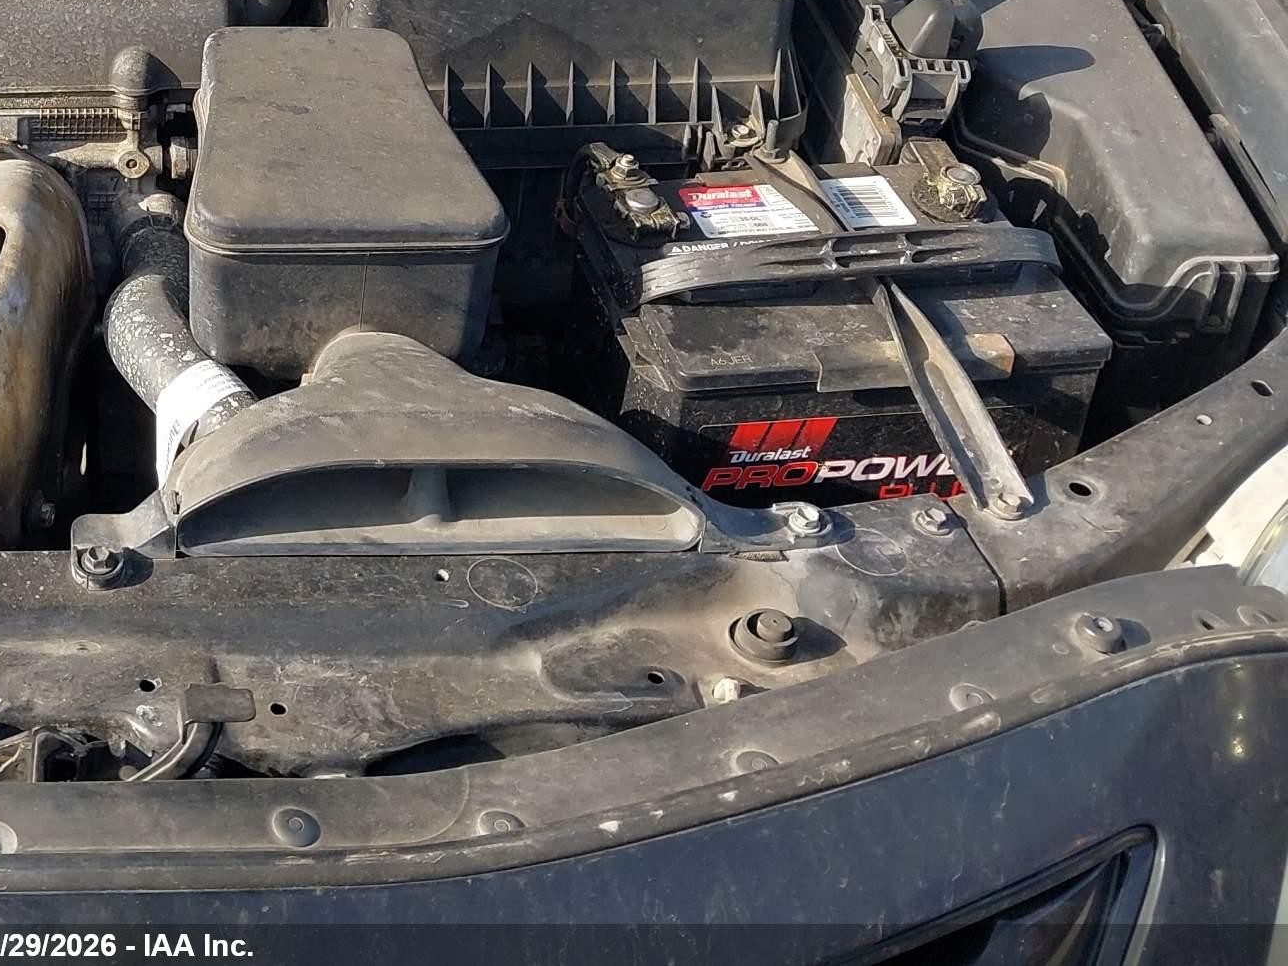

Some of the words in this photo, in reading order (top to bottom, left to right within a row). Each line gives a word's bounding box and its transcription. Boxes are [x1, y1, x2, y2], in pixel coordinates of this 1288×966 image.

[688, 188, 753, 202] Duralast
[682, 242, 729, 253] DANGER
[729, 445, 812, 464] Duralast
